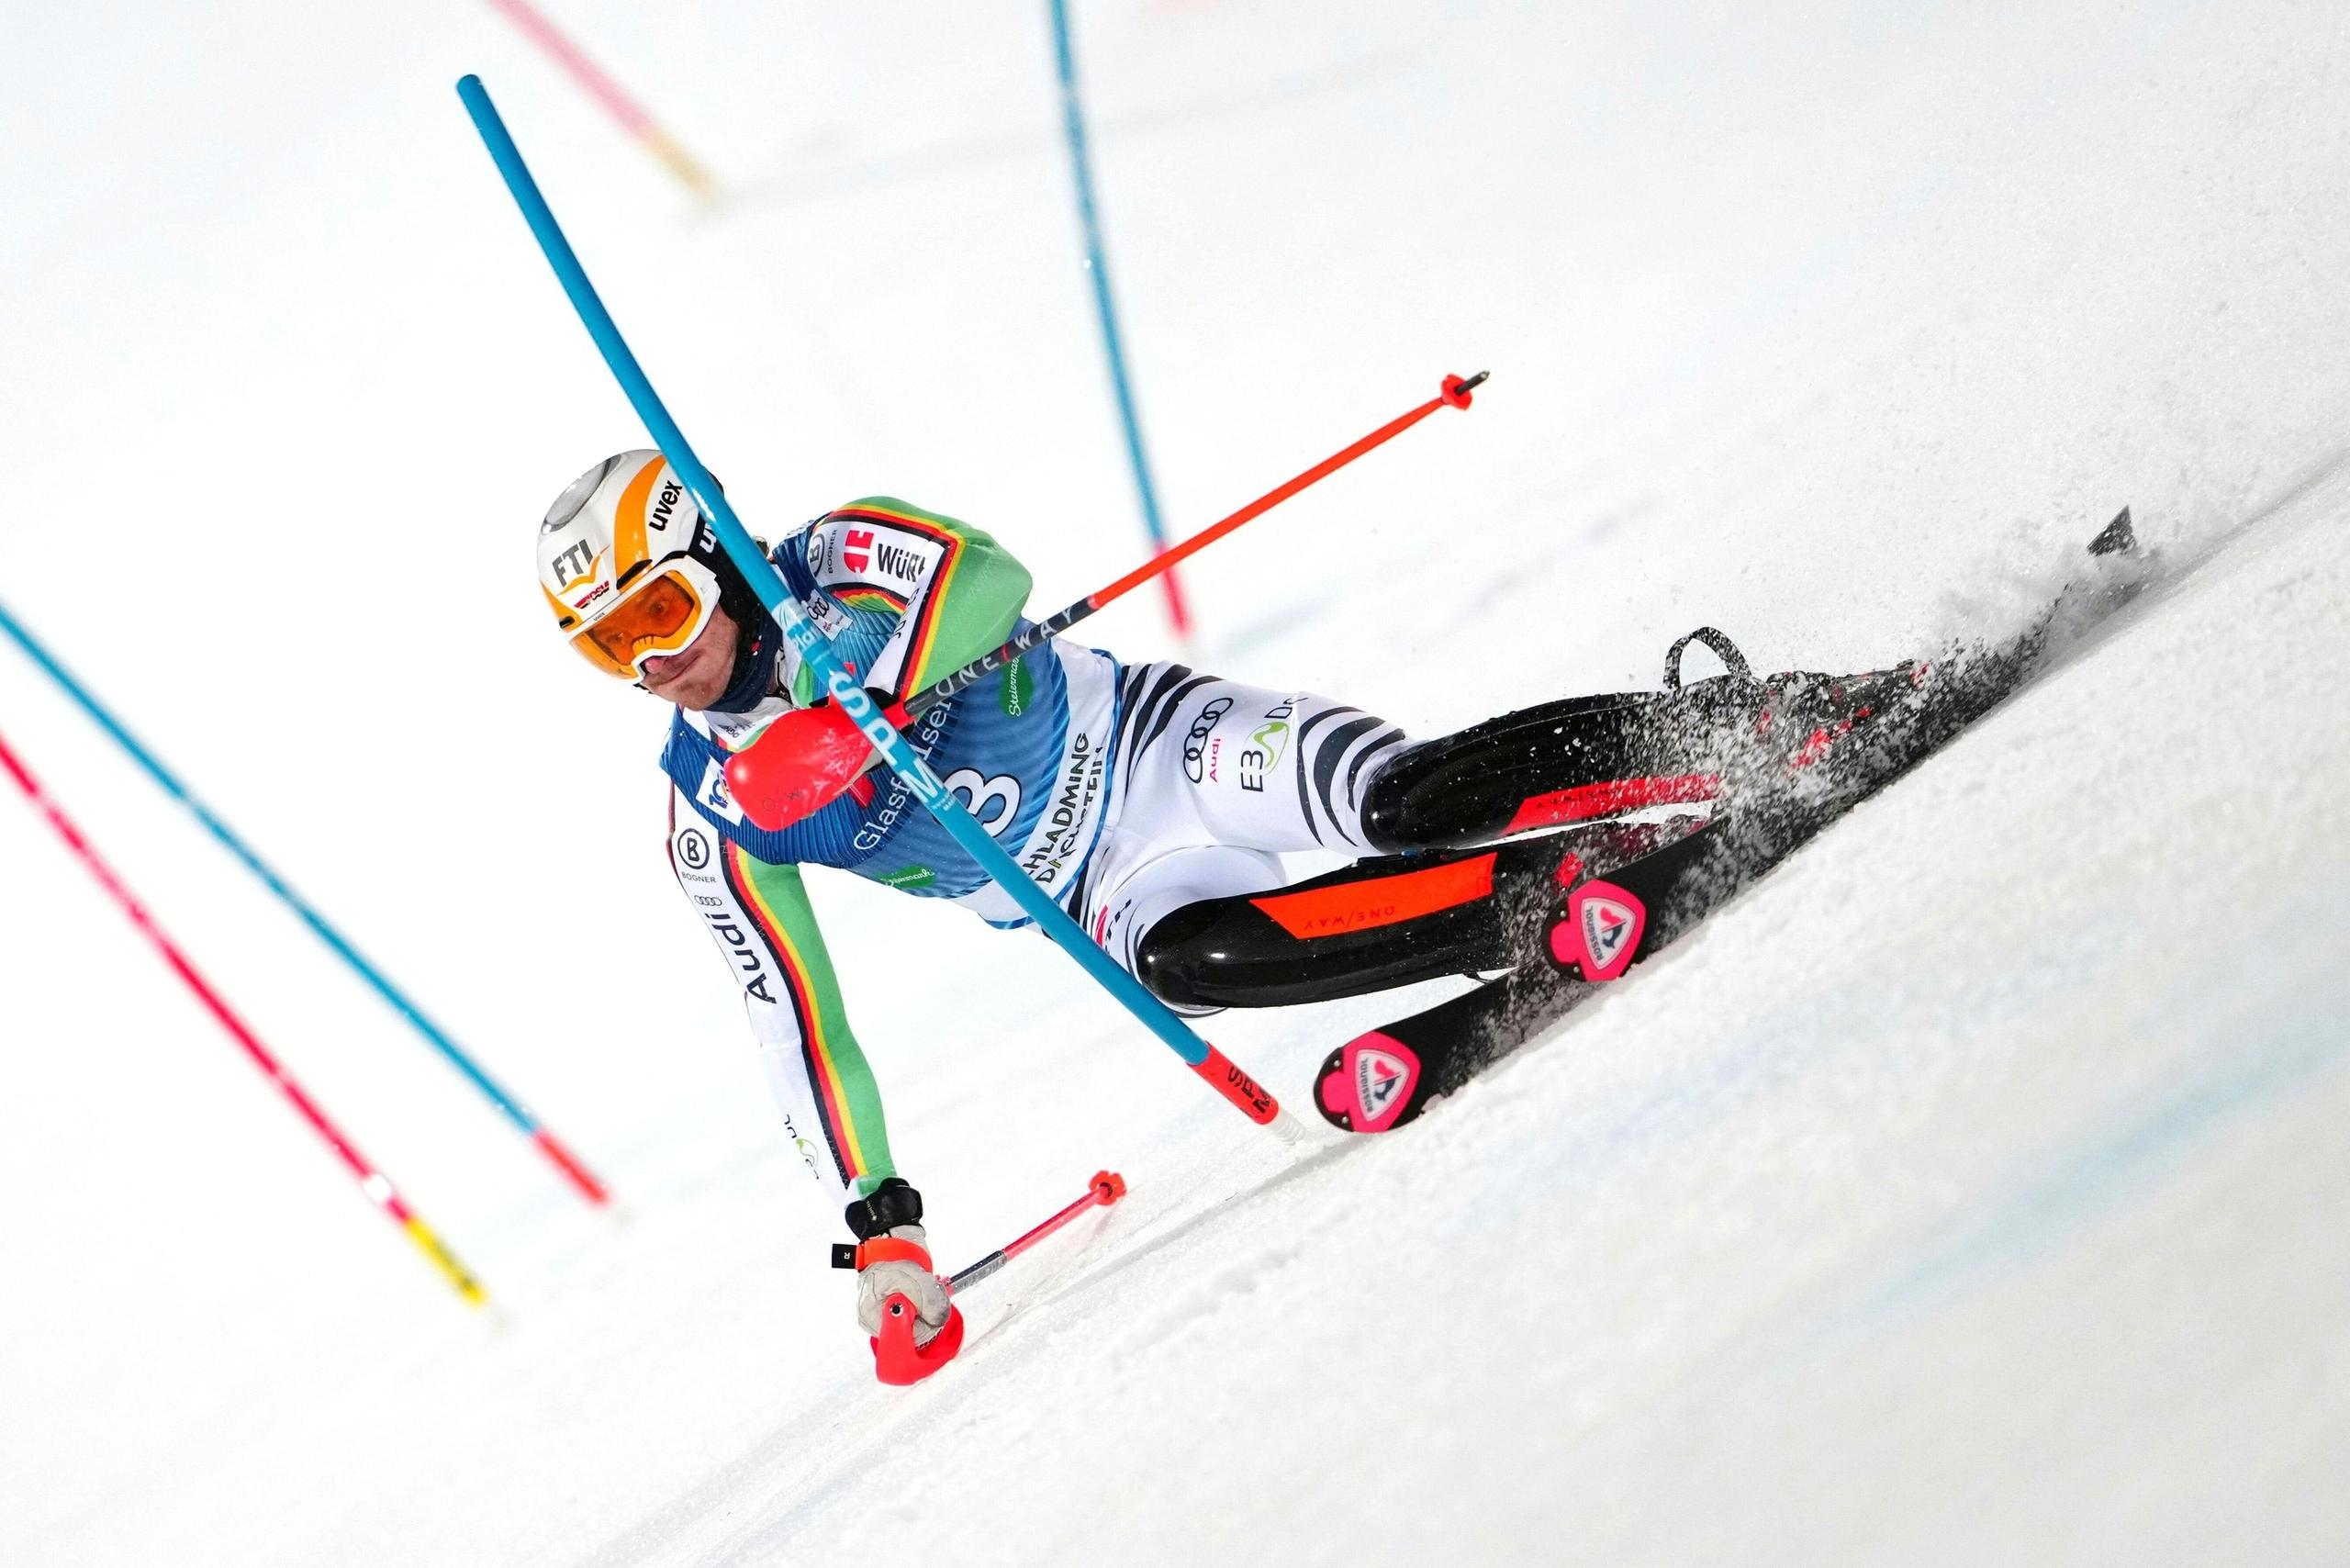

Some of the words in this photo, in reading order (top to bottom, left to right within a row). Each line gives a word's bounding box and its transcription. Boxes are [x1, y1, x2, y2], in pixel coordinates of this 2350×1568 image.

[648, 480, 683, 532] uvex
[552, 539, 594, 588] FTI
[829, 529, 837, 574] BOGNER
[877, 543, 925, 583] WÜR
[1009, 655, 1022, 717] Steiermar
[829, 671, 944, 804] SPM
[1209, 738, 1221, 783] Audi
[1021, 732, 1090, 876] HLADMING
[681, 871, 716, 883] BOGNER
[704, 913, 778, 1004] Audi
[1585, 906, 1605, 961] ROSSIGNOL
[1360, 1057, 1374, 1113] ROSSIGNOL
[844, 1251, 851, 1260] R
